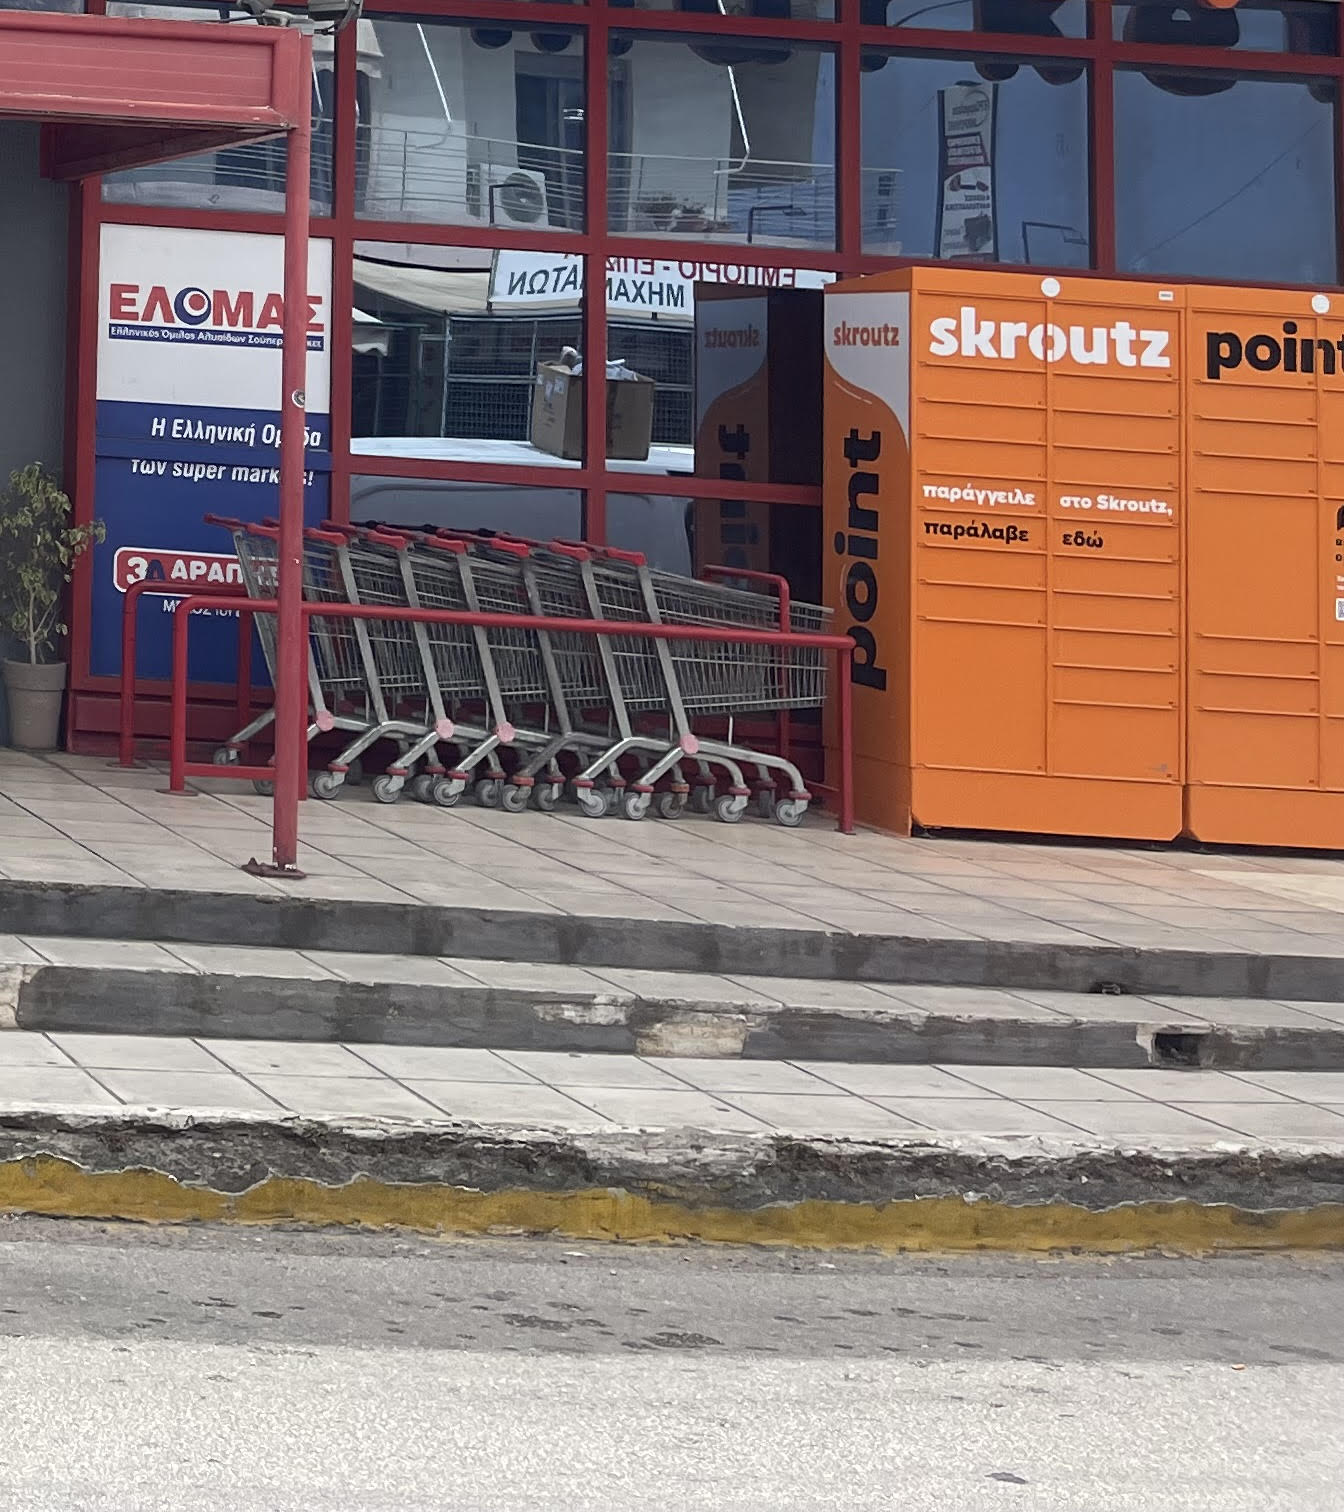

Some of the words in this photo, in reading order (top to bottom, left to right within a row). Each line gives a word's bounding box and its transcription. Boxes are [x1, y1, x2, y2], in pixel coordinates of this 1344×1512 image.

[833, 320, 900, 347] skroutz
[929, 306, 1171, 368] skroutz
[151, 417, 166, 437] Η
[171, 419, 257, 446] Ελληνική
[261, 423, 322, 448] Ομδα
[131, 458, 167, 475] των
[172, 462, 226, 482] super
[922, 482, 1036, 506] παράγγειλε
[1059, 495, 1092, 509] στο
[1096, 494, 1174, 516] Skroutz,
[923, 520, 1029, 544] παράλαβε
[1062, 529, 1104, 548] εδώ
[834, 428, 887, 692] point
